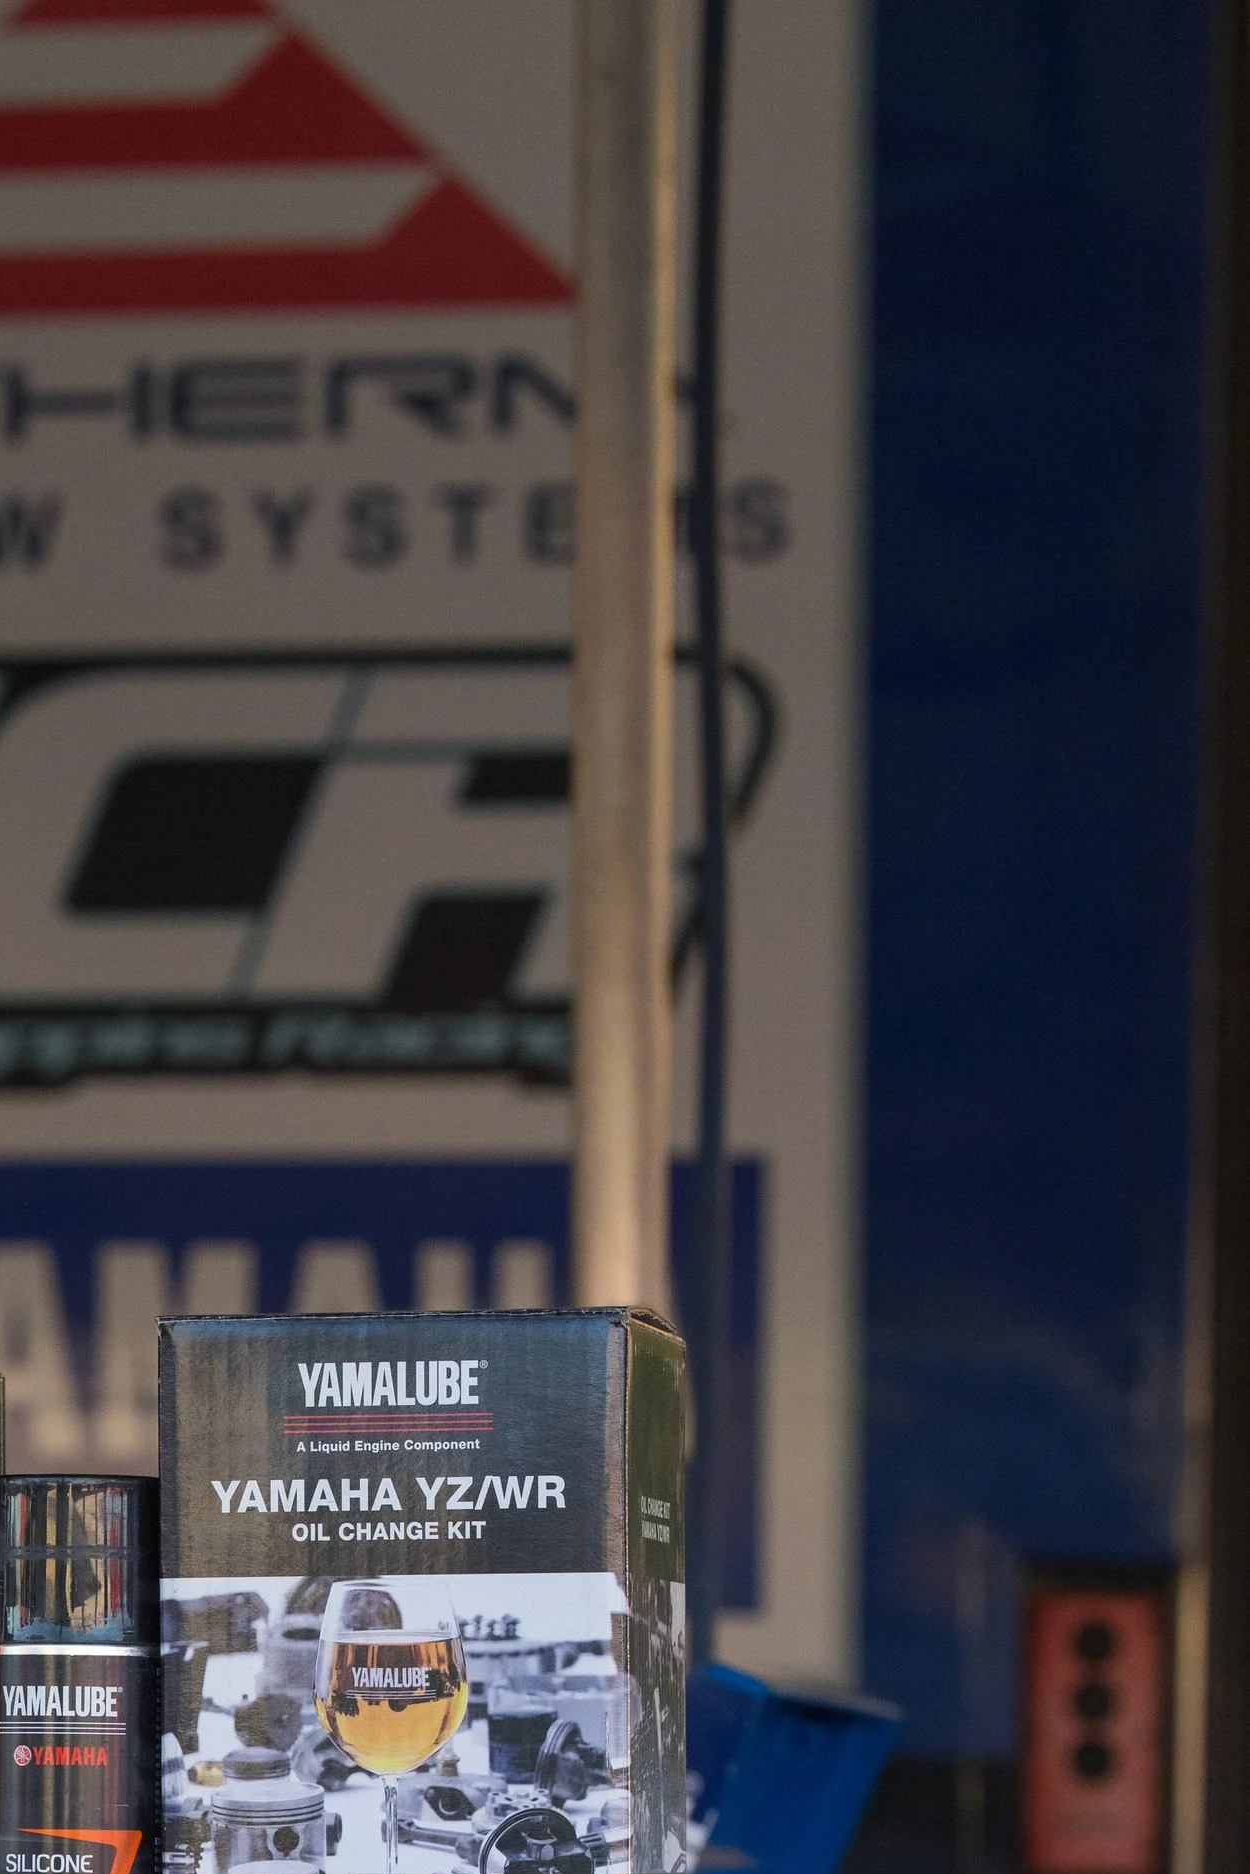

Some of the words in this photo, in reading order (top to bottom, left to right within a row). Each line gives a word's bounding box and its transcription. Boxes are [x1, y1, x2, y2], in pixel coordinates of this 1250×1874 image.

[161, 482, 792, 568] SYSTES
[297, 1440, 306, 1452] A
[310, 1440, 350, 1454] Liquid
[355, 1440, 399, 1454] Engine
[404, 1439, 480, 1452] Component
[211, 1478, 402, 1513] YAMAHA
[416, 1475, 566, 1510] YZ/WR
[292, 1524, 330, 1541] OIL
[338, 1522, 439, 1540] CHANGE
[448, 1521, 486, 1539] KIT
[352, 1667, 430, 1688] YAMALUBE
[33, 1747, 107, 1766] YAMAHA
[6, 1854, 93, 1873] SILICONE
